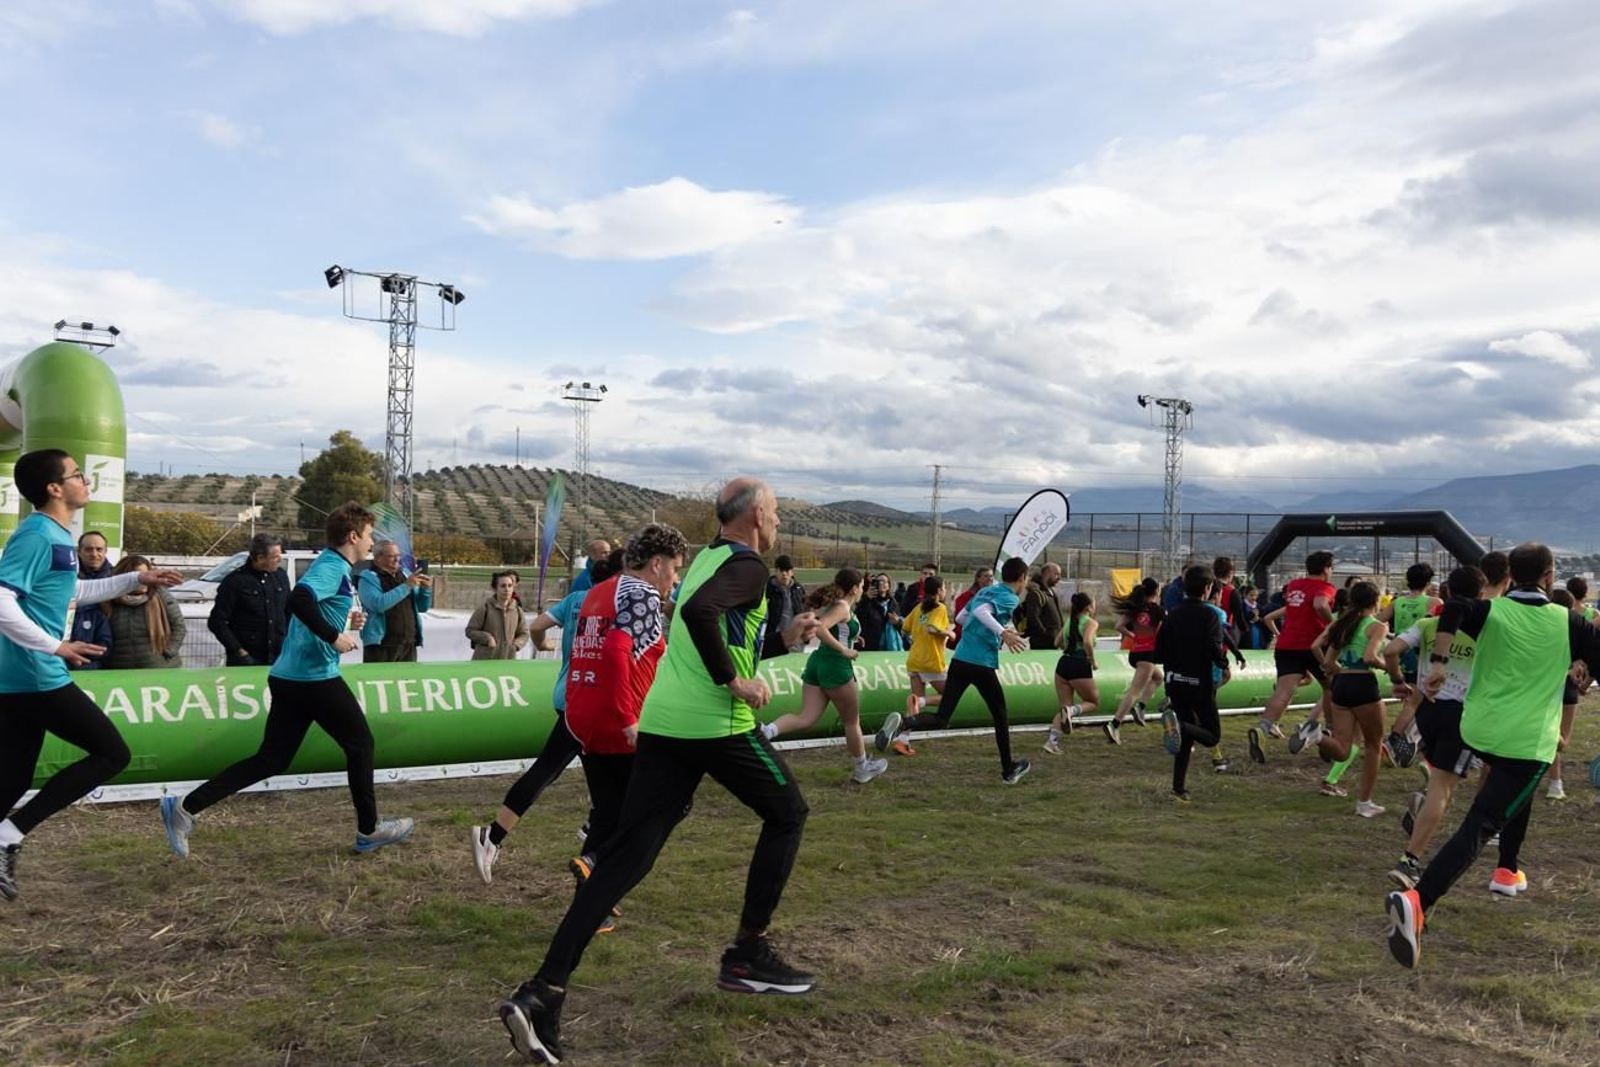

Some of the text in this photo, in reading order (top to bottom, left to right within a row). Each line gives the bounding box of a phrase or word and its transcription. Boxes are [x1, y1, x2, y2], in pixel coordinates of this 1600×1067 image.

[1448, 642, 1476, 659] ULS
[852, 659, 912, 691] RAÍS
[994, 662, 1051, 686] RIOR
[83, 675, 530, 724] ARAÍS TERIOR
